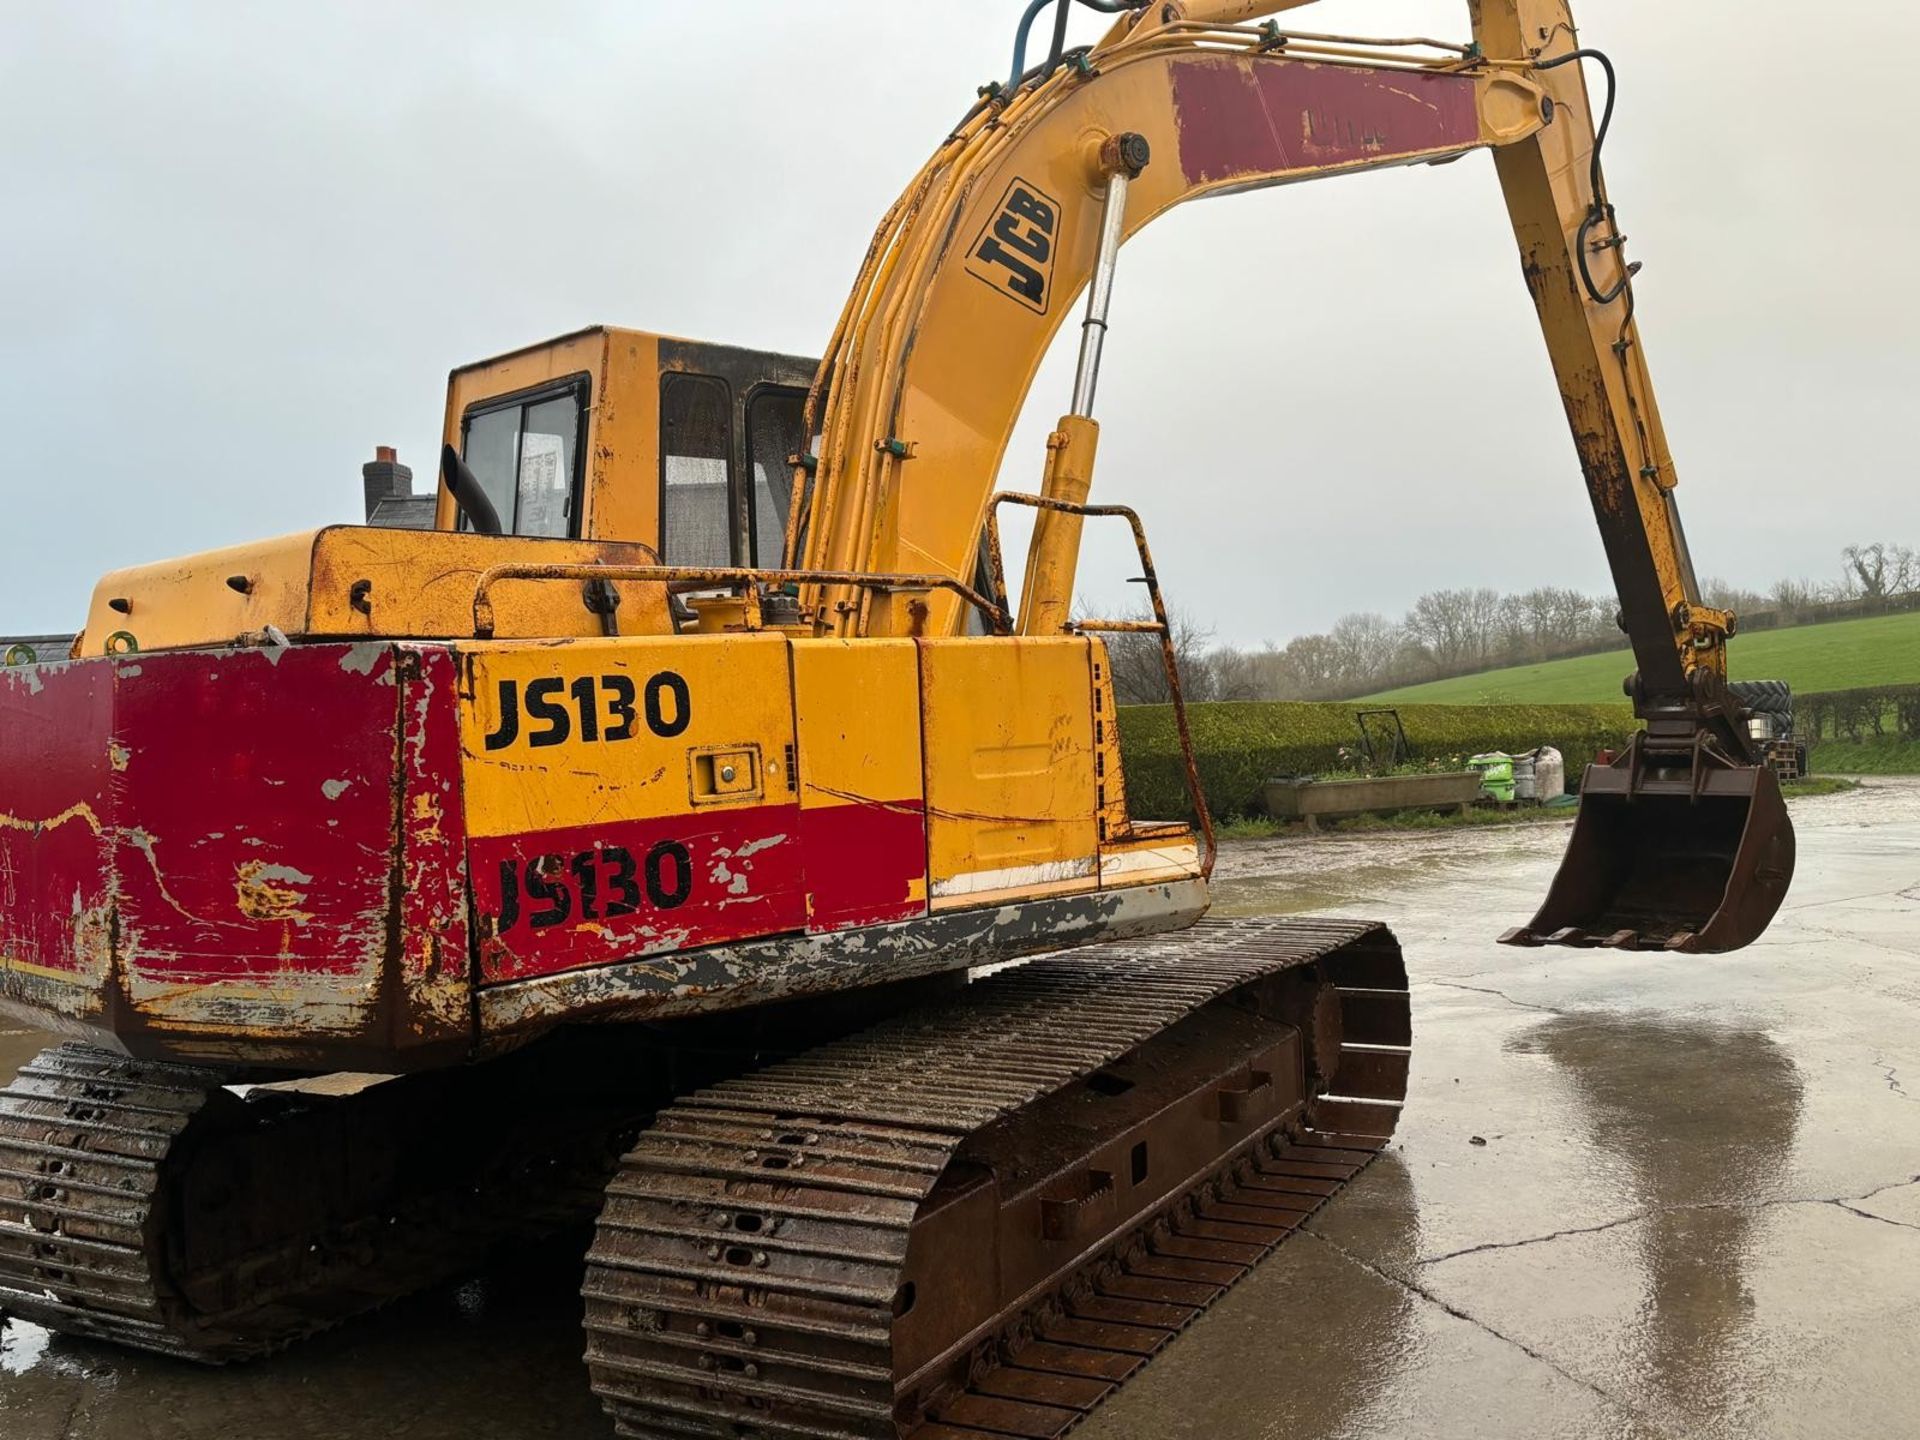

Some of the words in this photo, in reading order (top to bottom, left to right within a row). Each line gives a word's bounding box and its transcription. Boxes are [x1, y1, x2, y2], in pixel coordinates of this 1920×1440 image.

[976, 187, 1054, 305] JCB
[484, 671, 691, 751] JS130
[496, 840, 692, 934] JS130
